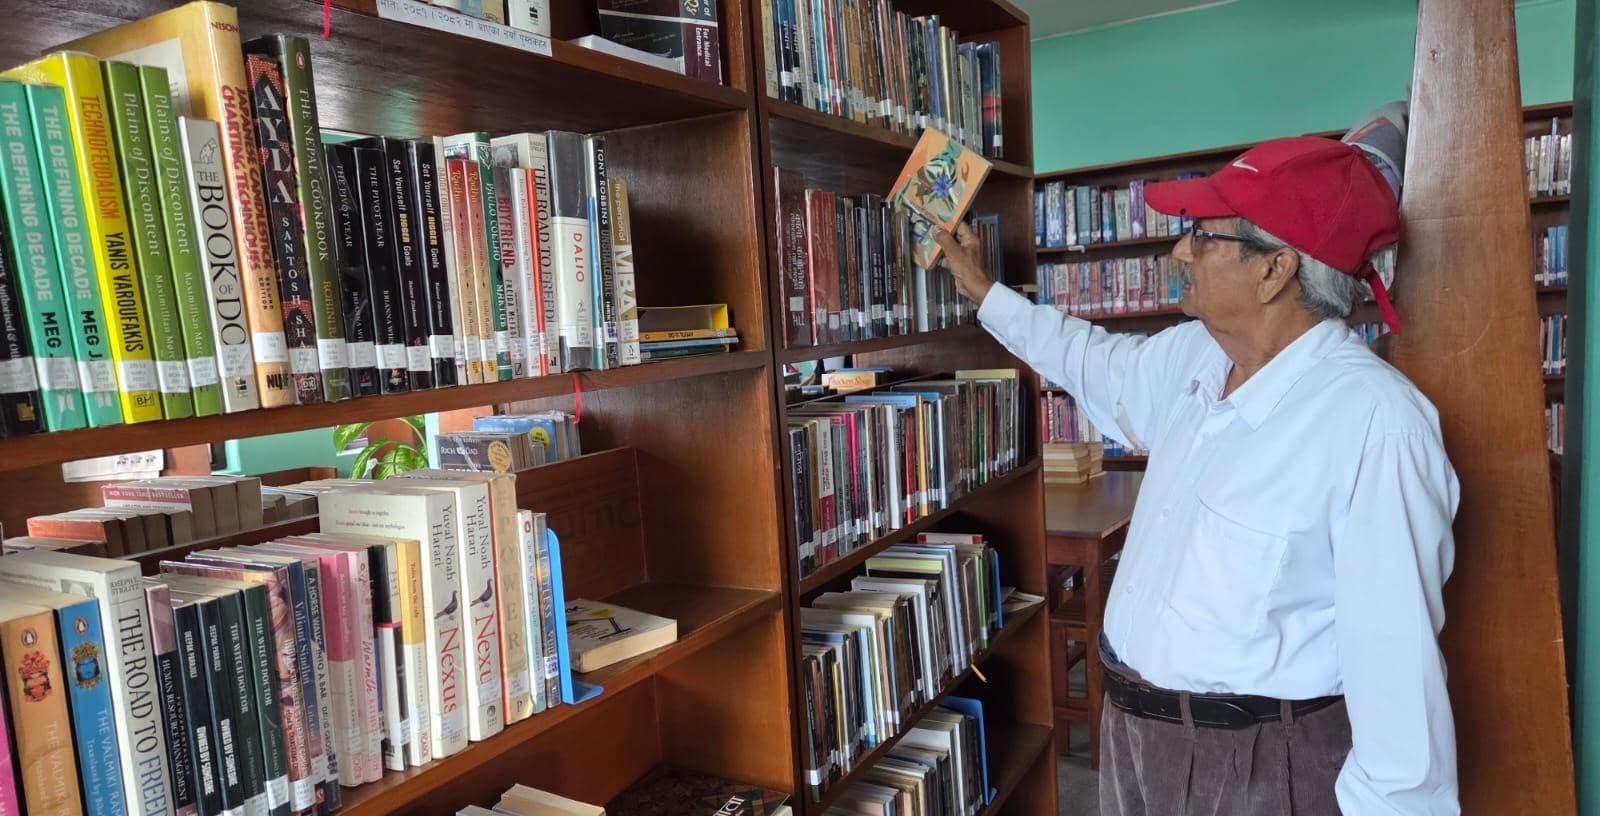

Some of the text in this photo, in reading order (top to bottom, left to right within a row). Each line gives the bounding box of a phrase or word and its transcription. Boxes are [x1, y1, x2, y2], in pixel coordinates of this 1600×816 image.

[704, 40, 712, 67] Medical
[80, 95, 120, 219] TECHNOFEUDALISM
[235, 85, 257, 167] JAPANESE
[1, 102, 54, 301] THE DEFINING DECADE
[42, 106, 92, 300] THE DEFINING DECADE
[124, 93, 160, 256] Plains of Discontent
[155, 94, 189, 254] Plains of Discontent
[222, 85, 262, 270] CHARTING TECHNIQUES
[299, 88, 329, 261] THE NEPAL COOKBOOK
[336, 165, 352, 248] THE PIVOT YEAR
[369, 166, 385, 247] THE PIVOT YEAR
[395, 176, 407, 211] Yourself
[485, 183, 497, 216] PAULO
[535, 165, 546, 194] THE
[597, 148, 608, 226] TONY ROBBINS
[400, 213, 410, 243] BIGGER
[422, 163, 440, 269] Set Yourself BIGGER Goals
[490, 219, 501, 261] COELHO
[536, 198, 549, 242] ROAD
[615, 201, 626, 242] personal
[105, 232, 129, 270] YANIS
[197, 171, 248, 346] THE BOOK OF DO
[282, 217, 301, 304] SANTOSH
[403, 245, 414, 267] Goals
[541, 245, 551, 267] TO
[573, 232, 585, 282] DALIO
[614, 249, 637, 317] MBA
[41, 311, 62, 348] MEG
[81, 310, 100, 346] MEG
[113, 275, 144, 353] VAROUFAKIS
[323, 281, 337, 326] ROHINI
[384, 290, 394, 328] BRIANNA
[504, 279, 517, 339] FREIDA McFAD
[543, 271, 554, 323] FREED
[433, 523, 443, 568] Harari
[442, 504, 457, 581] Yuval Noah
[467, 514, 479, 556] Harari
[476, 496, 492, 569] Yuval Noah
[118, 608, 145, 656] THE
[184, 630, 194, 653] DEEPAK
[209, 624, 218, 646] DEEPAK
[295, 601, 305, 642] Valiant
[308, 589, 319, 617] HORSE
[318, 683, 327, 699] BAR
[475, 611, 496, 685] Nexu
[123, 654, 154, 720] ROAD
[230, 622, 249, 714] THE WITCH DOCTOR
[255, 617, 273, 706] THE WITCH DOCTOR
[440, 627, 460, 714] Nexus
[48, 721, 60, 750] THE
[96, 708, 118, 788] THE VALMIKI
[134, 720, 159, 754] TO
[162, 659, 187, 801] HUMAN RESOURCE MANAGEMENT
[196, 725, 214, 796] OWNED BY SOMEONE
[220, 718, 238, 788] OWNED BY SOMEONE
